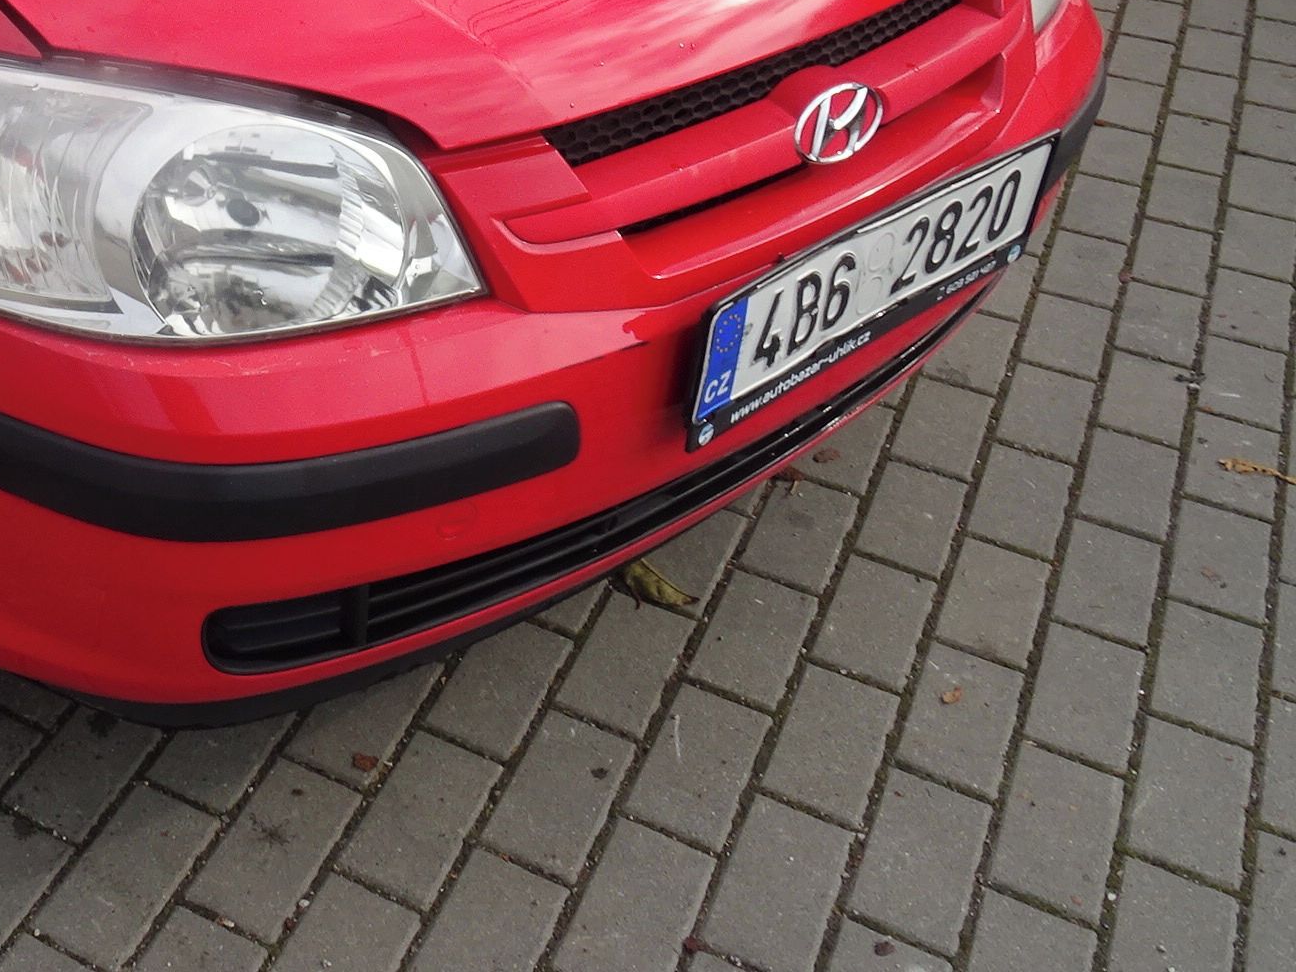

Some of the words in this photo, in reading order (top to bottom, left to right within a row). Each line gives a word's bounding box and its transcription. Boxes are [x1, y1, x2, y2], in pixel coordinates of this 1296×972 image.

[751, 251, 856, 368] 4B6
[889, 169, 1022, 295] 2820
[704, 369, 732, 404] CZ
